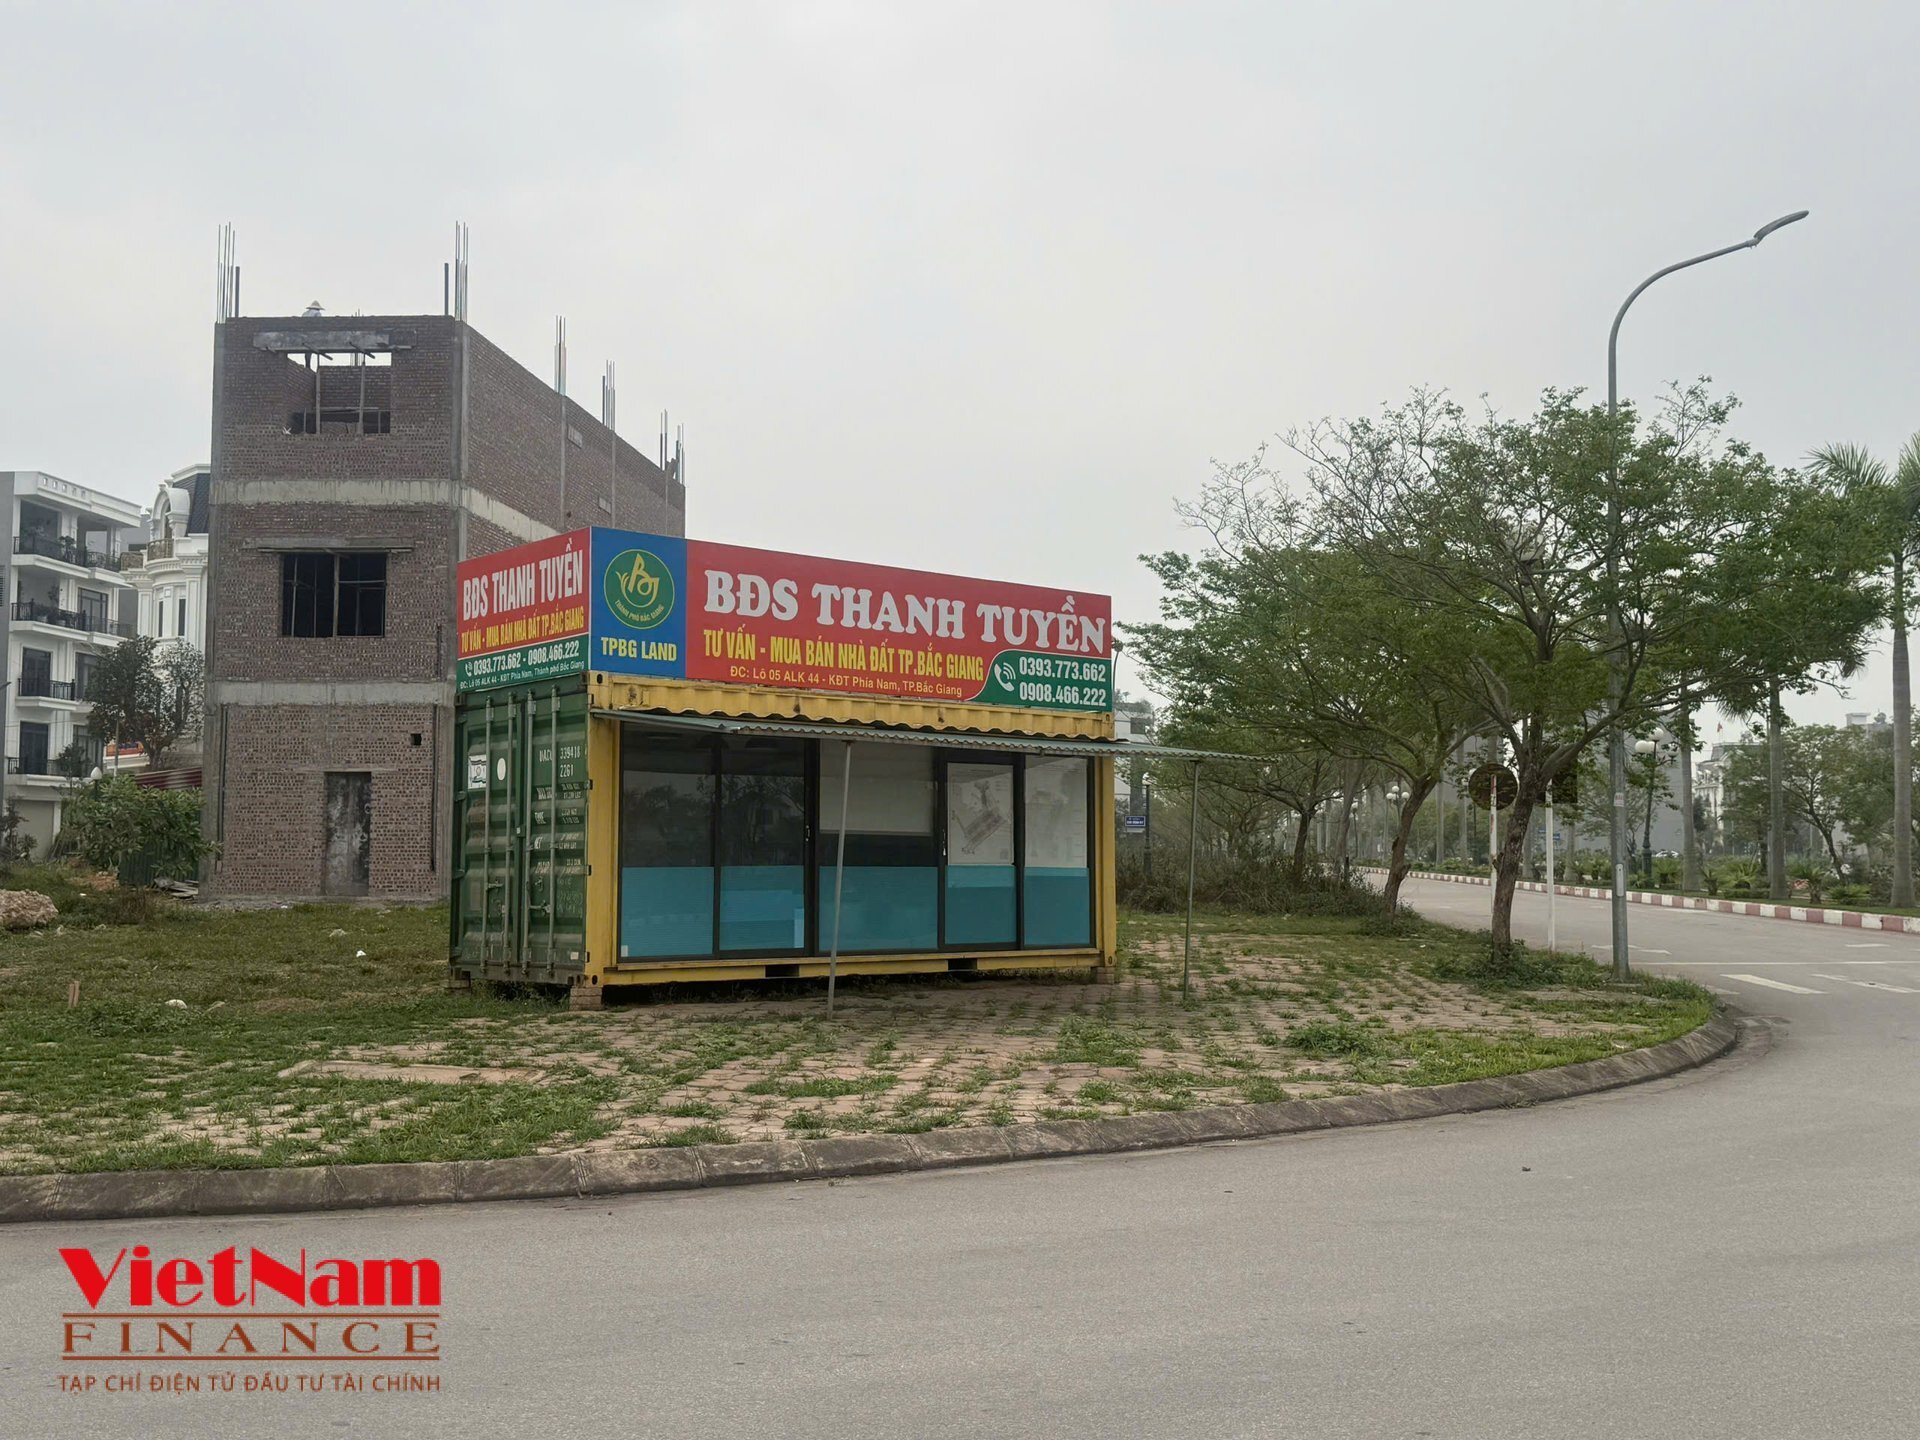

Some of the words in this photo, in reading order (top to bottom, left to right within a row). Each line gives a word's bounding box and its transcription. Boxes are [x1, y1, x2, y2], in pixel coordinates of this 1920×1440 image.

[463, 574, 488, 621] BĐS
[492, 562, 536, 614] THANH
[486, 626, 499, 648] MUA
[564, 606, 584, 631] GIANG
[703, 569, 799, 621] BĐS
[812, 582, 966, 639] THANH
[976, 594, 1106, 654] TUYỀN
[473, 652, 521, 676] 0393.773.662
[527, 640, 580, 666] 0908.466.222
[601, 636, 637, 658] TPBG
[641, 640, 677, 662] LAND
[704, 628, 724, 658] TƯ
[726, 623, 756, 660] VẤN
[770, 636, 802, 665] MUA
[805, 635, 834, 668] BÁN
[838, 639, 867, 671] NHÀ
[870, 638, 895, 674] ĐẤT
[898, 642, 943, 678] TP.BẮC
[946, 653, 984, 681] GIANG
[730, 665, 750, 678] ĐC:
[752, 670, 767, 680] Lô
[769, 670, 781, 681] 05
[783, 671, 806, 683] ALK
[807, 673, 820, 684] 44
[828, 674, 850, 687] KĐT
[852, 676, 874, 688] Phía
[876, 678, 901, 692] Nam,
[902, 679, 934, 694] TP.Bắc
[936, 683, 962, 697] Giang
[1018, 656, 1107, 682] 0393.773.662
[1019, 682, 1107, 707] 0908.466.222
